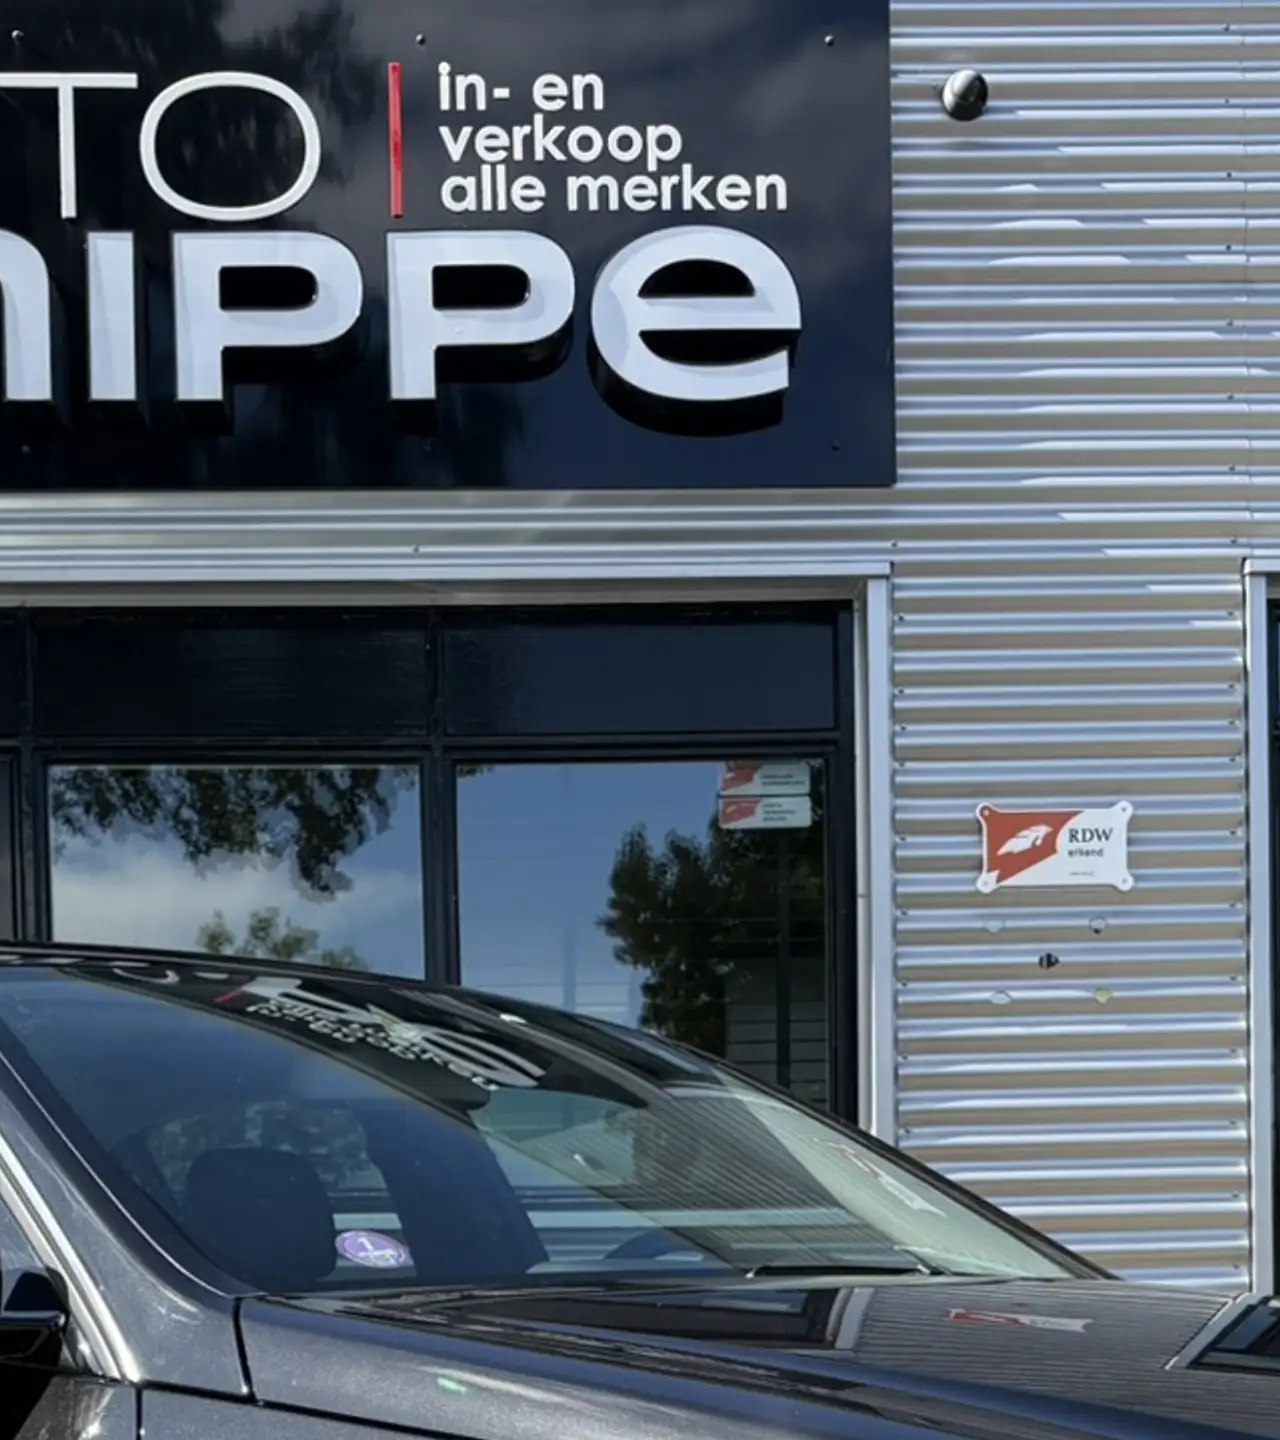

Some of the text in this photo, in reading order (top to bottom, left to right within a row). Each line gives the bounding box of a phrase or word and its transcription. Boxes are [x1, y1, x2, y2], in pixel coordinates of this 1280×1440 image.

[438, 61, 604, 112] in- en
[438, 113, 683, 172] verkoop
[440, 163, 788, 212] alle merken
[1068, 828, 1113, 843] RDW
